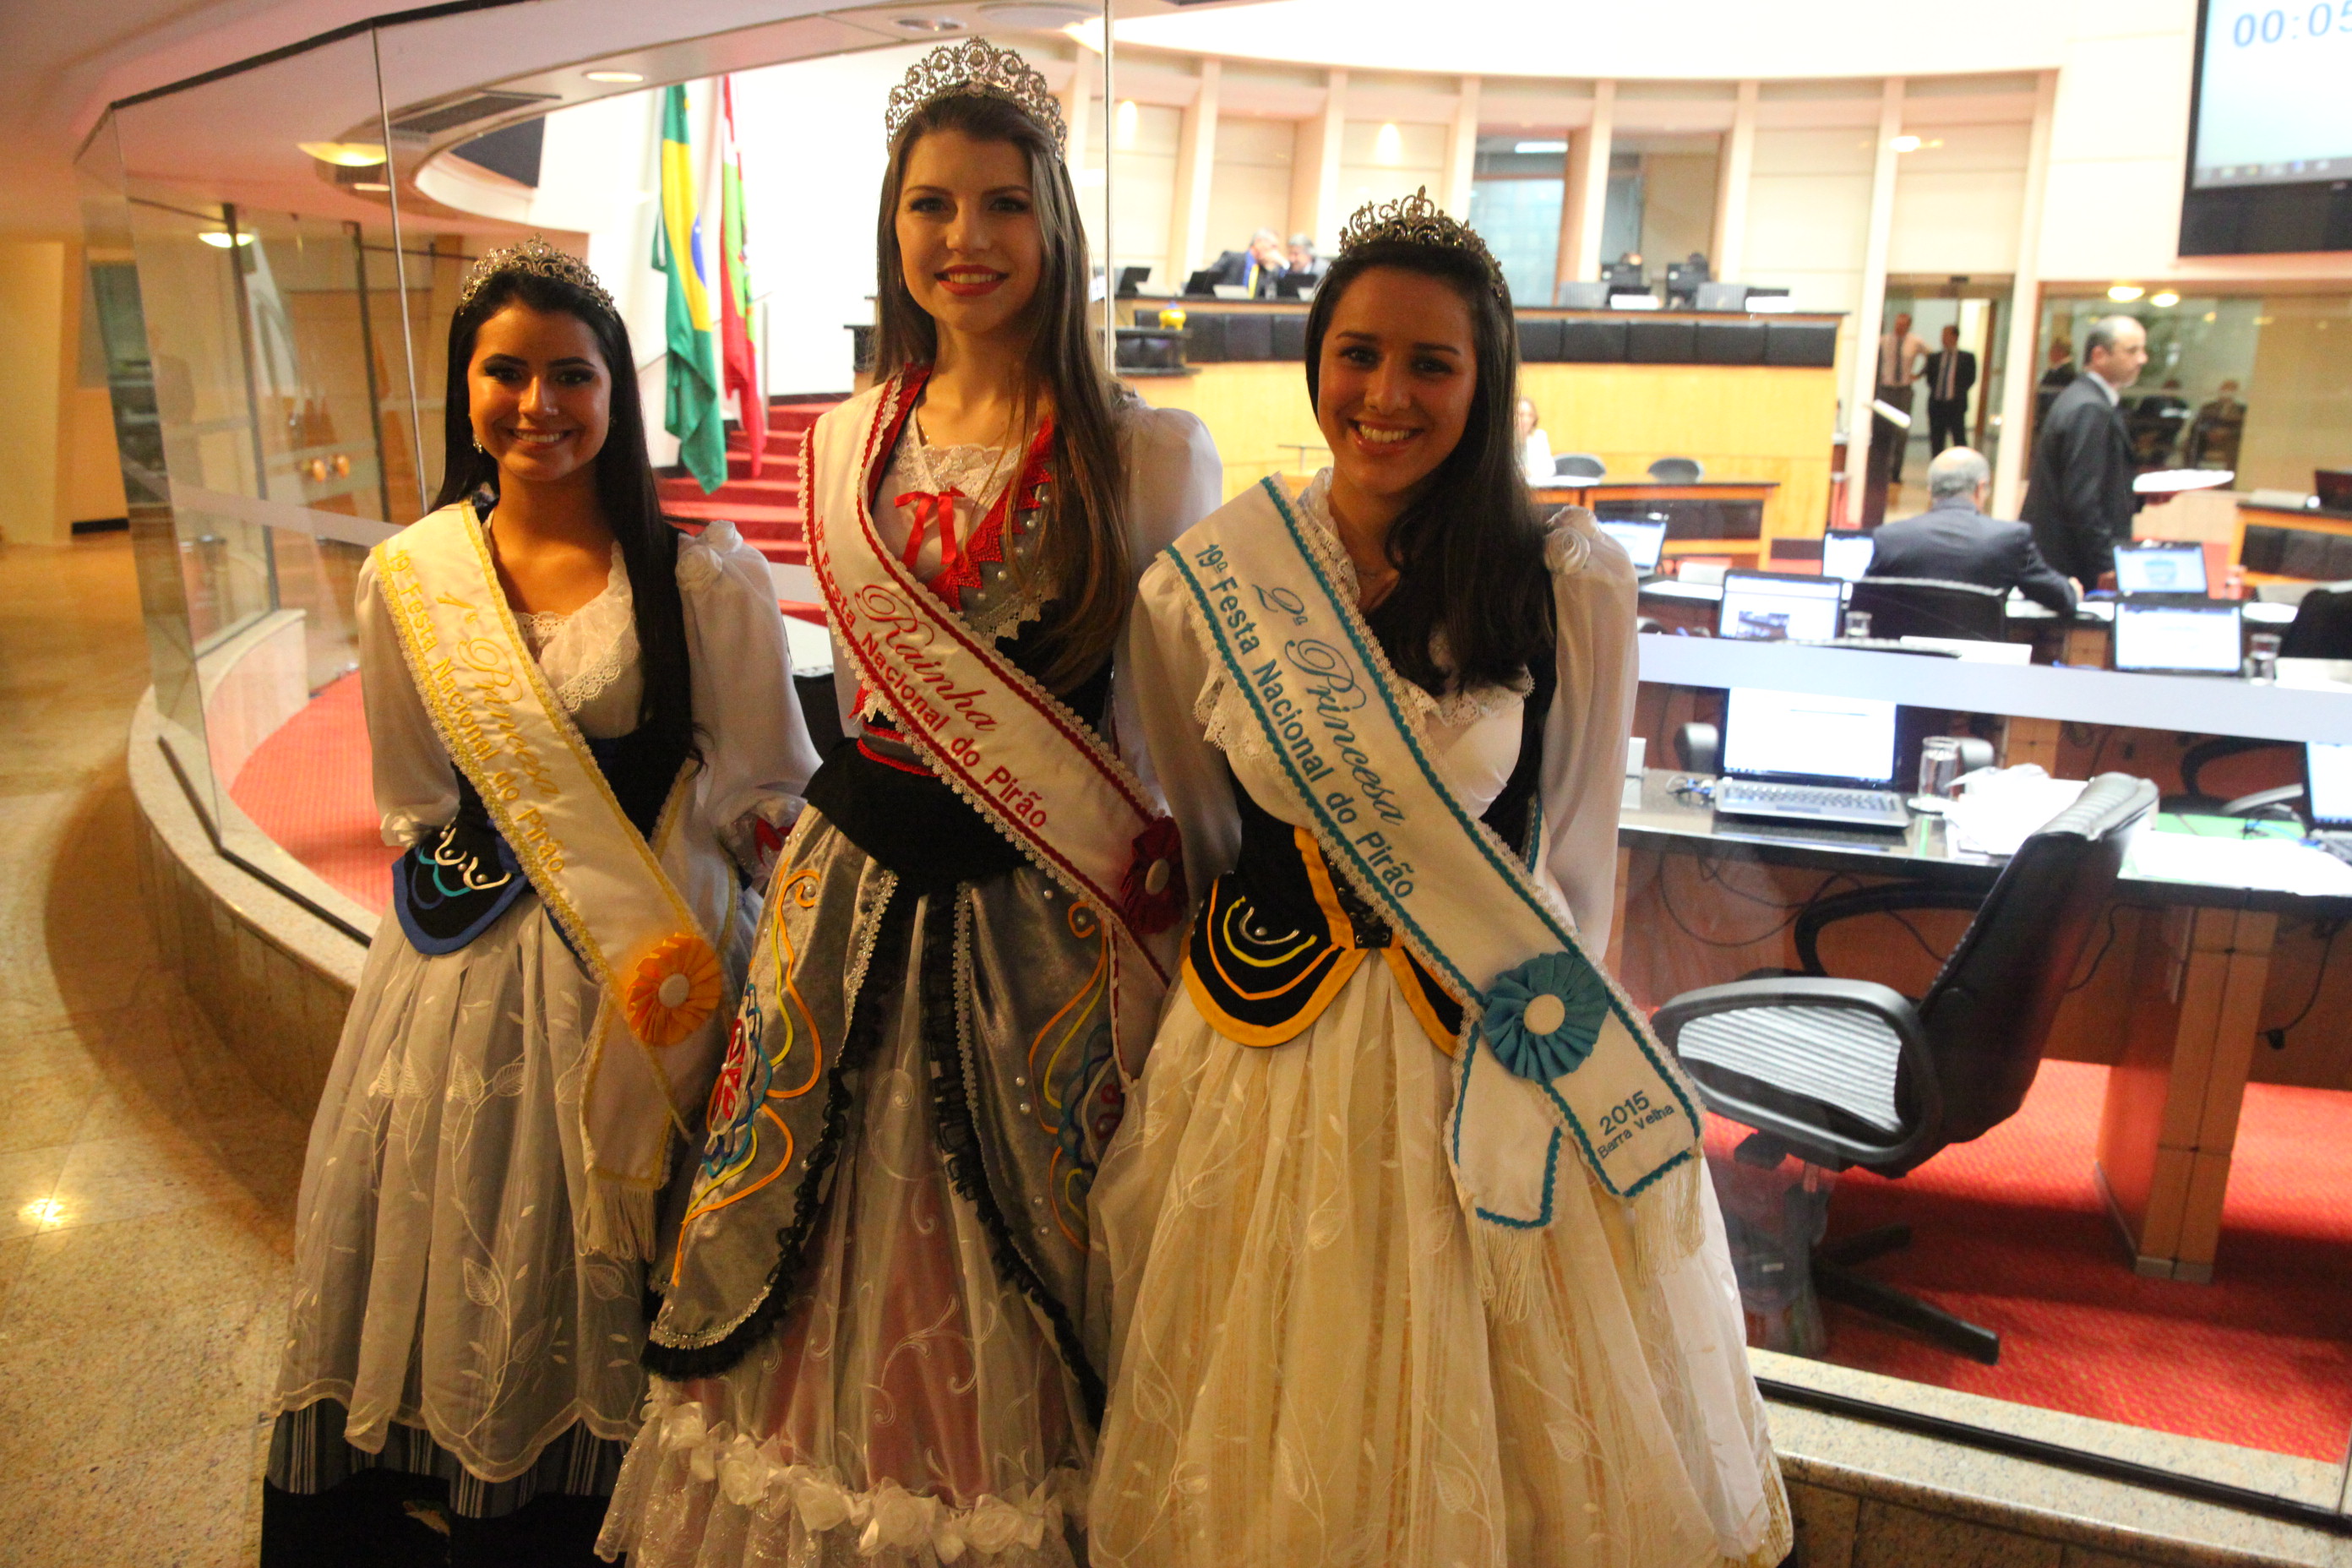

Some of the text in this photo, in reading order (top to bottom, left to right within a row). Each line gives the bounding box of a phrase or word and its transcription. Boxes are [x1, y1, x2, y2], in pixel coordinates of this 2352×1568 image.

[399, 581, 438, 653] Festa
[432, 656, 501, 762] Nacional
[493, 770, 520, 801] do
[515, 807, 567, 872] Pirão
[457, 637, 561, 797] Princesa
[854, 584, 998, 732] Rainha
[861, 632, 951, 733] Nacional
[950, 737, 981, 768] do
[984, 765, 1048, 830] Pirão
[1210, 576, 1260, 655] Festa
[1251, 658, 1334, 783] Nacional
[1326, 792, 1358, 825] do
[1355, 830, 1415, 899] Pirão
[1284, 639, 1408, 826] Princesa
[1596, 1103, 1675, 1160] Barra Velha
[1598, 1091, 1651, 1135] 2015
